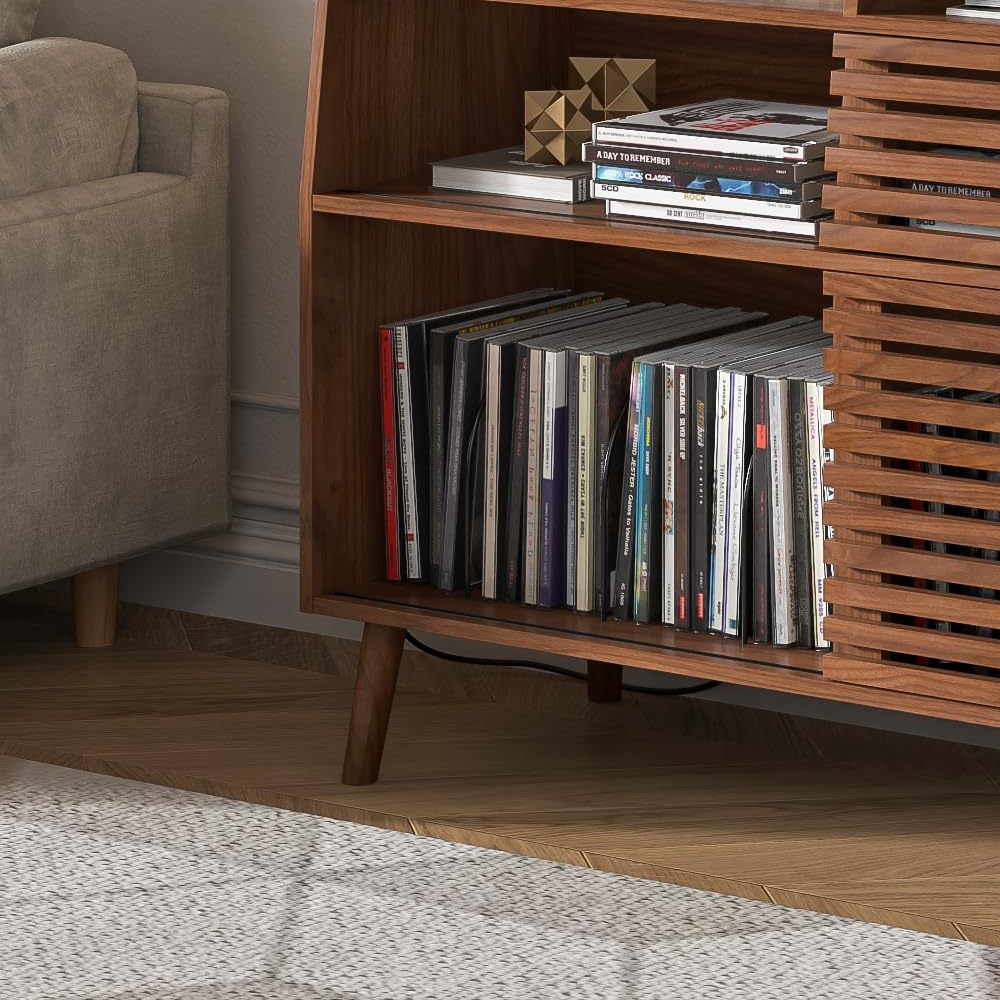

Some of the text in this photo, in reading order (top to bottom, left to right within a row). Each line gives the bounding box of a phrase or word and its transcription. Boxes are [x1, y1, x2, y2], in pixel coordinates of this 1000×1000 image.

[596, 151, 602, 159] A
[603, 151, 619, 160] DAY
[619, 153, 629, 162] TO
[630, 154, 671, 165] REMEMBER
[601, 184, 619, 192] 5CD
[683, 193, 707, 201] ROCK
[631, 423, 640, 456] MORBID
[679, 451, 685, 460] UP
[629, 456, 638, 488] JESTER
[626, 494, 634, 516] Gates
[626, 517, 632, 526] to
[623, 527, 632, 556] Valhalla
[817, 579, 823, 595] MM
